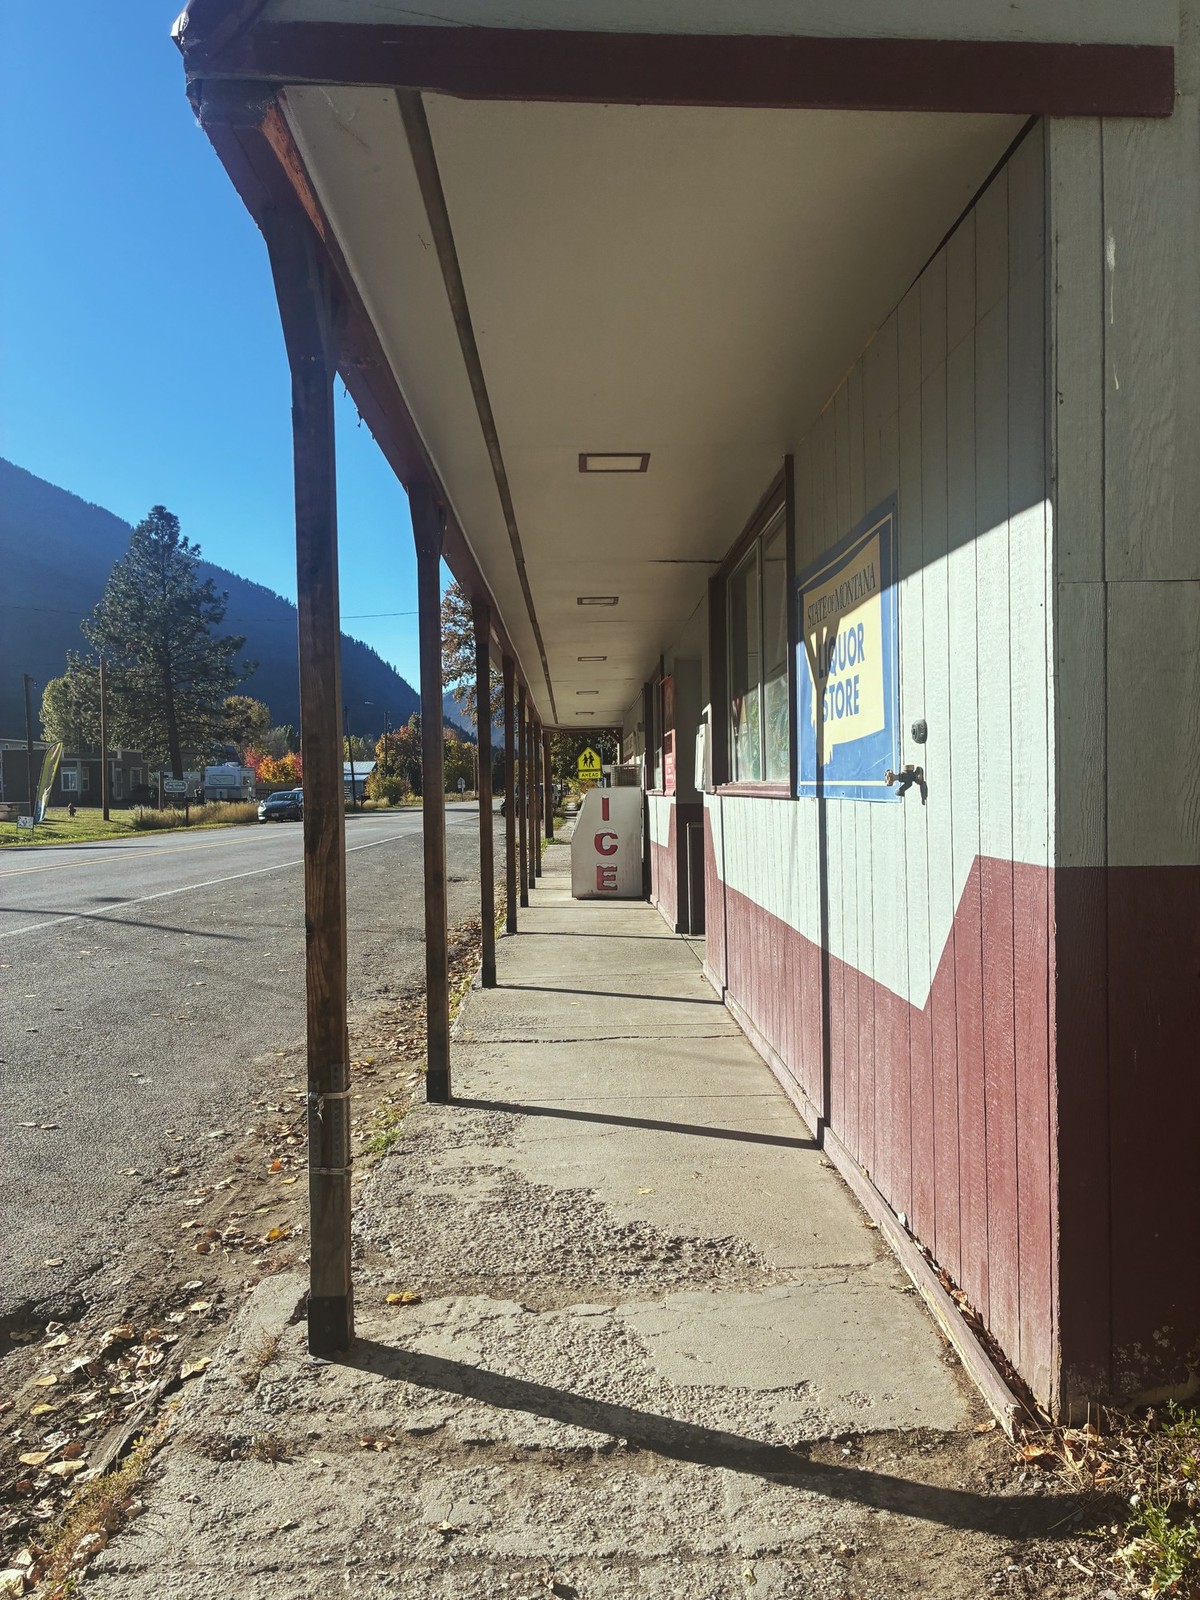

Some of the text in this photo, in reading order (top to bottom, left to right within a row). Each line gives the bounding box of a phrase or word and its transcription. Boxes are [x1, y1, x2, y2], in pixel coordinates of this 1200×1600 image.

[808, 562, 876, 629] STATE OF MONTANA
[818, 622, 865, 679] LIQUOR
[822, 674, 860, 722] STORE
[594, 794, 618, 891] ICE
